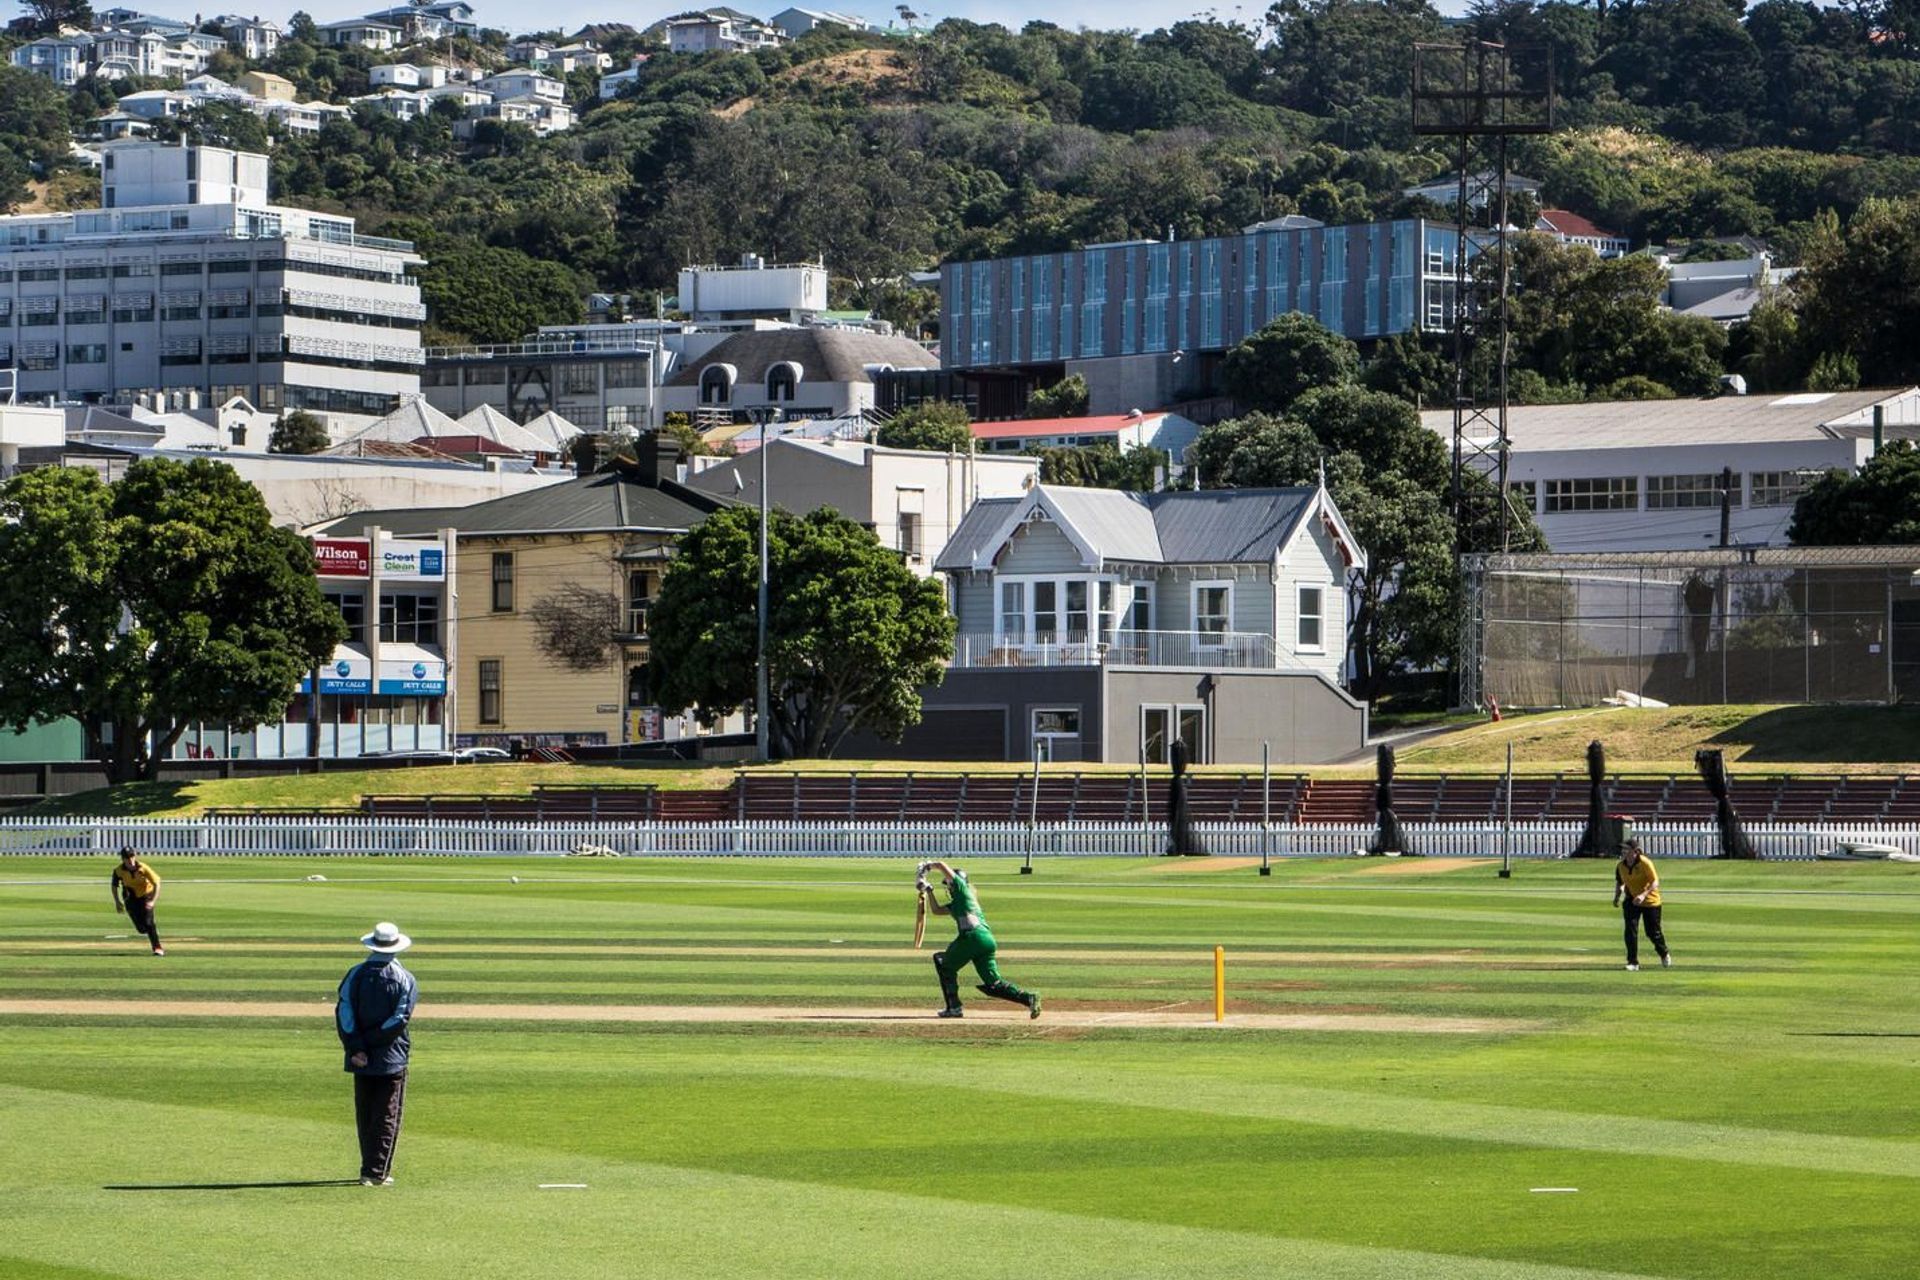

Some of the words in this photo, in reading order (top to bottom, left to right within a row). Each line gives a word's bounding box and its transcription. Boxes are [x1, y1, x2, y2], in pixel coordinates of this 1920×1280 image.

[315, 546, 359, 559] Wilson
[384, 552, 415, 562] Crest
[384, 562, 416, 571] Clean
